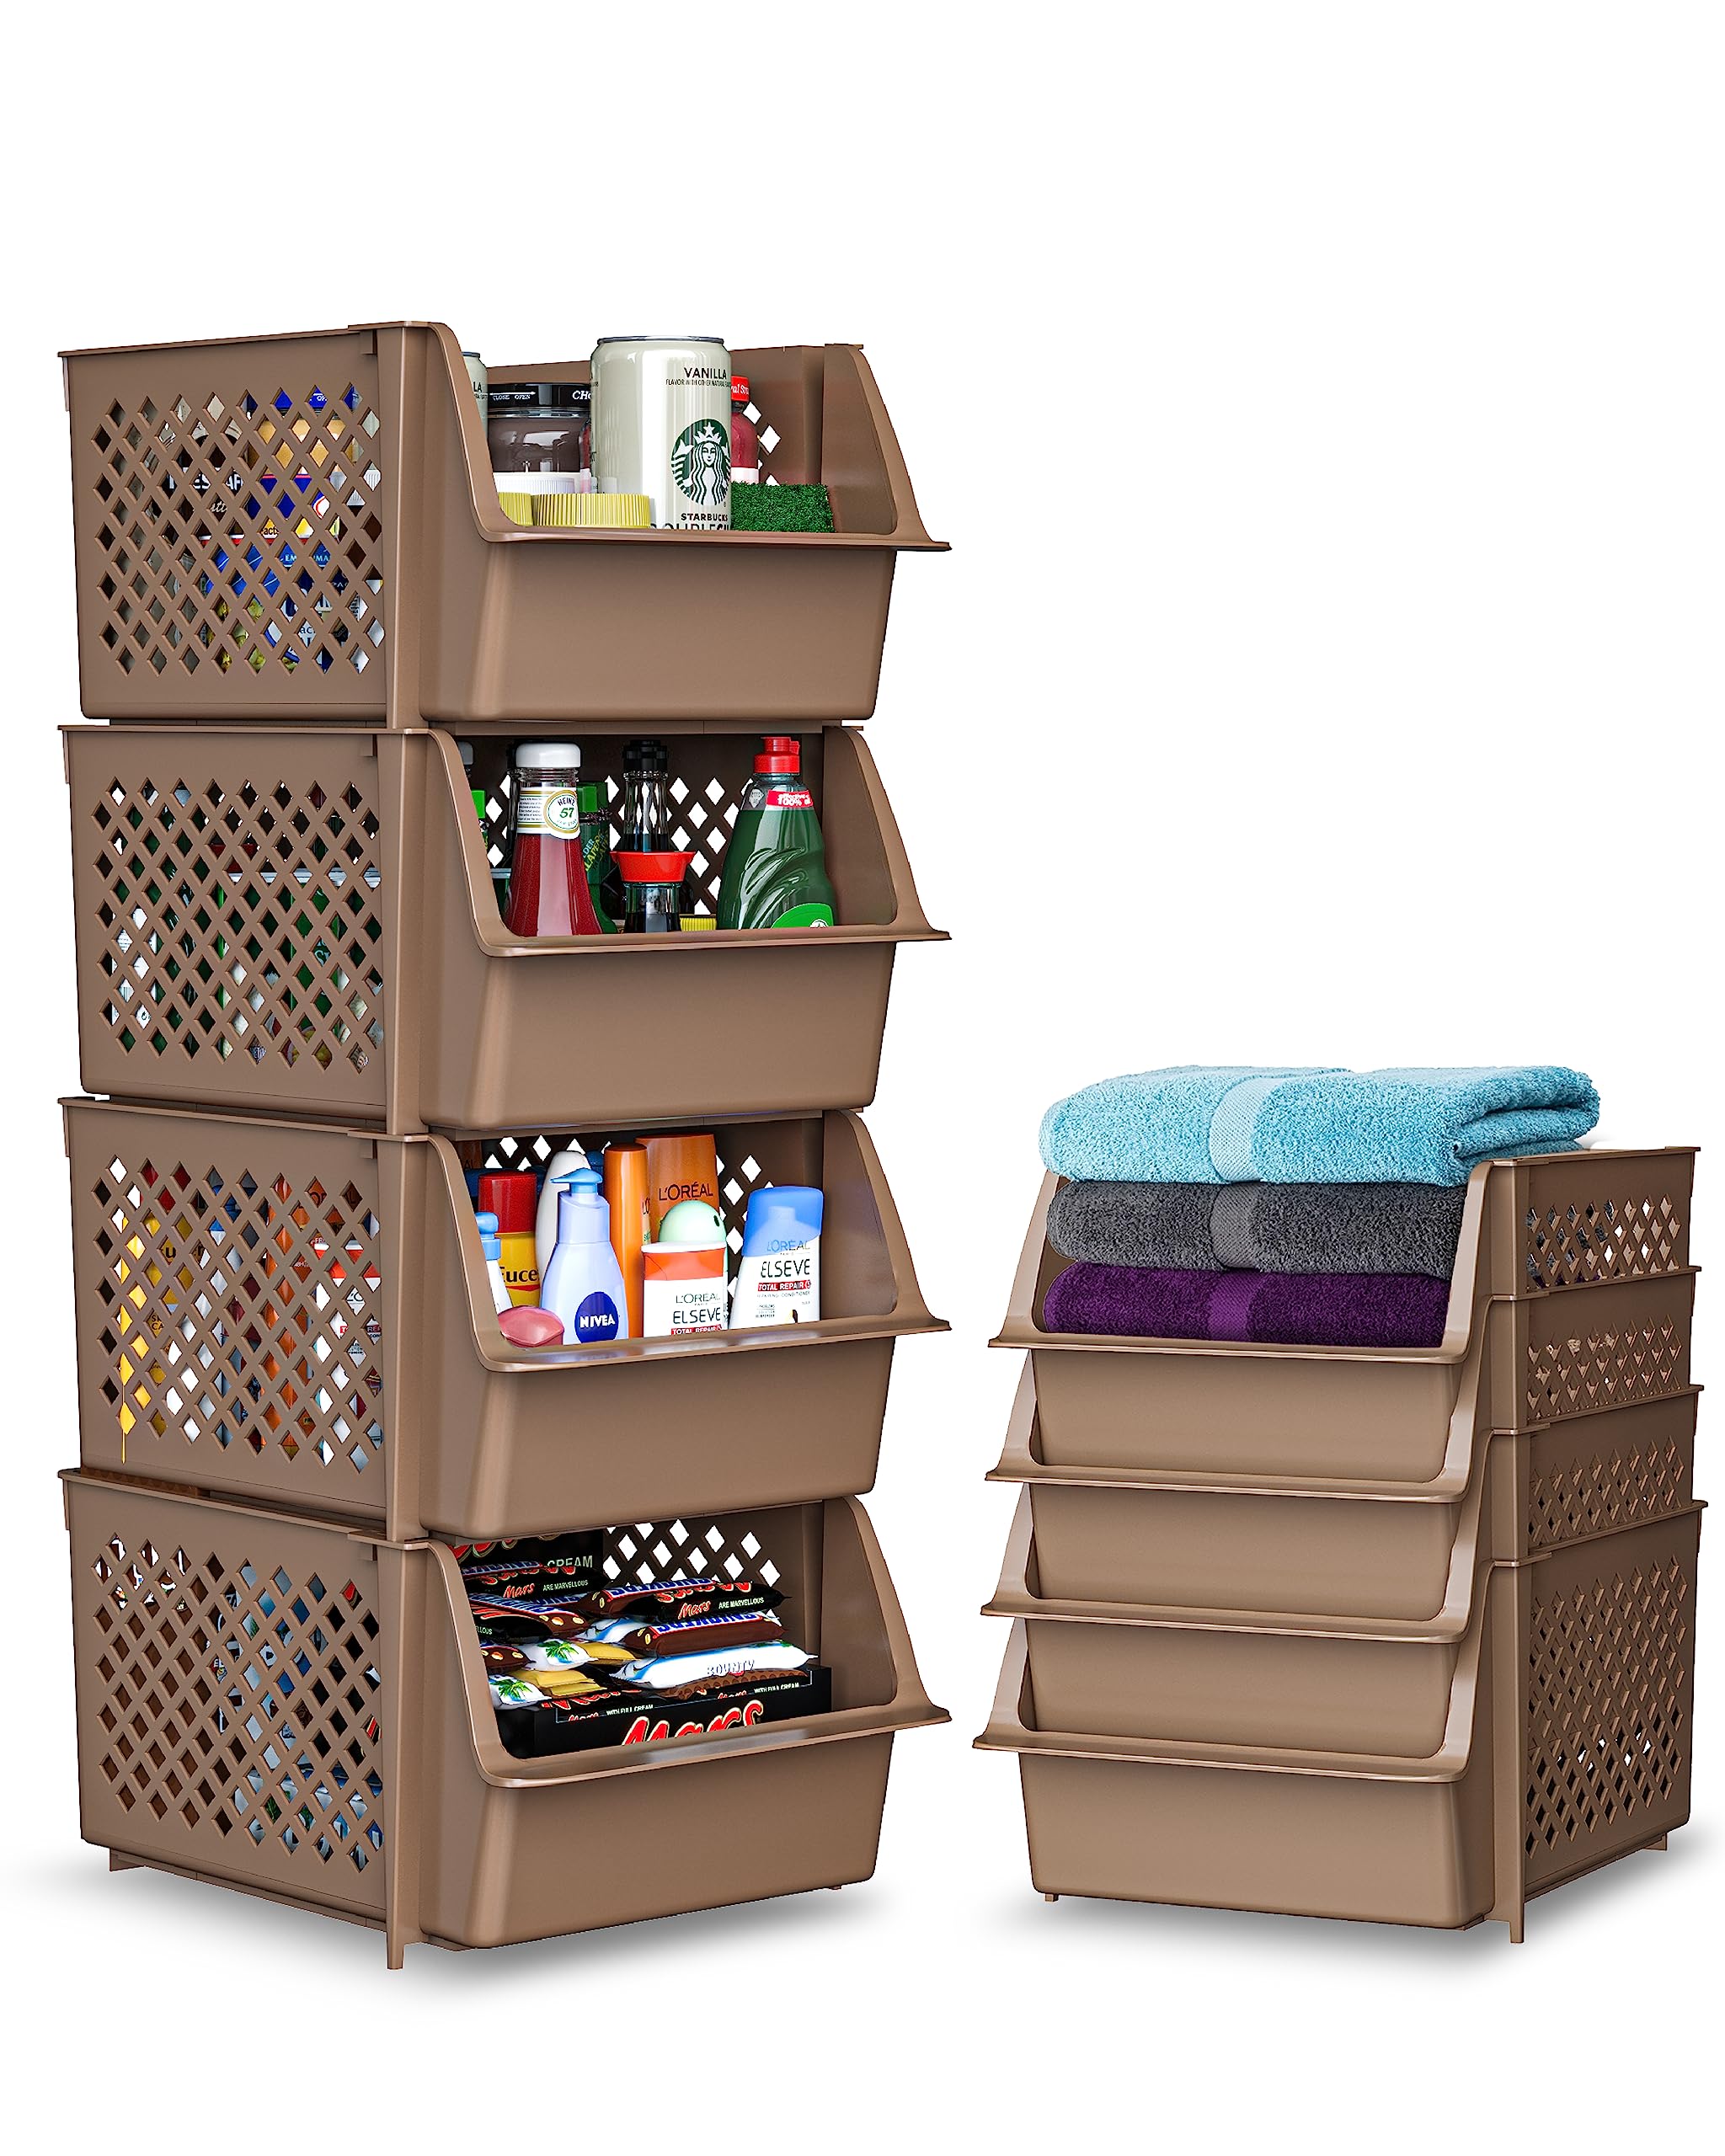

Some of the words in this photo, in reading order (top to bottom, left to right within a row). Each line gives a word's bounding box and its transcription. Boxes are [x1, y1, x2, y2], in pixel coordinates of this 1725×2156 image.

[684, 367, 727, 379] VANILLA
[681, 512, 729, 522] STARBUCKS
[558, 797, 575, 807] HEINZ
[559, 807, 574, 819] 57
[659, 1181, 714, 1201] L'ORÉAL
[760, 1258, 810, 1278] ELSEVE
[758, 1283, 778, 1291] TOTAL
[779, 1281, 804, 1290] REPAIR
[579, 1313, 616, 1328] NIVEA
[673, 1307, 721, 1325] ELSEVE
[547, 1555, 593, 1568] CREAM
[503, 1582, 536, 1598] Mars
[542, 1583, 554, 1592] ARE
[554, 1579, 589, 1590] MARVELLOUS
[677, 1600, 712, 1620] Mars
[718, 1600, 729, 1609] ARE
[729, 1597, 765, 1609] MARVELLOUS
